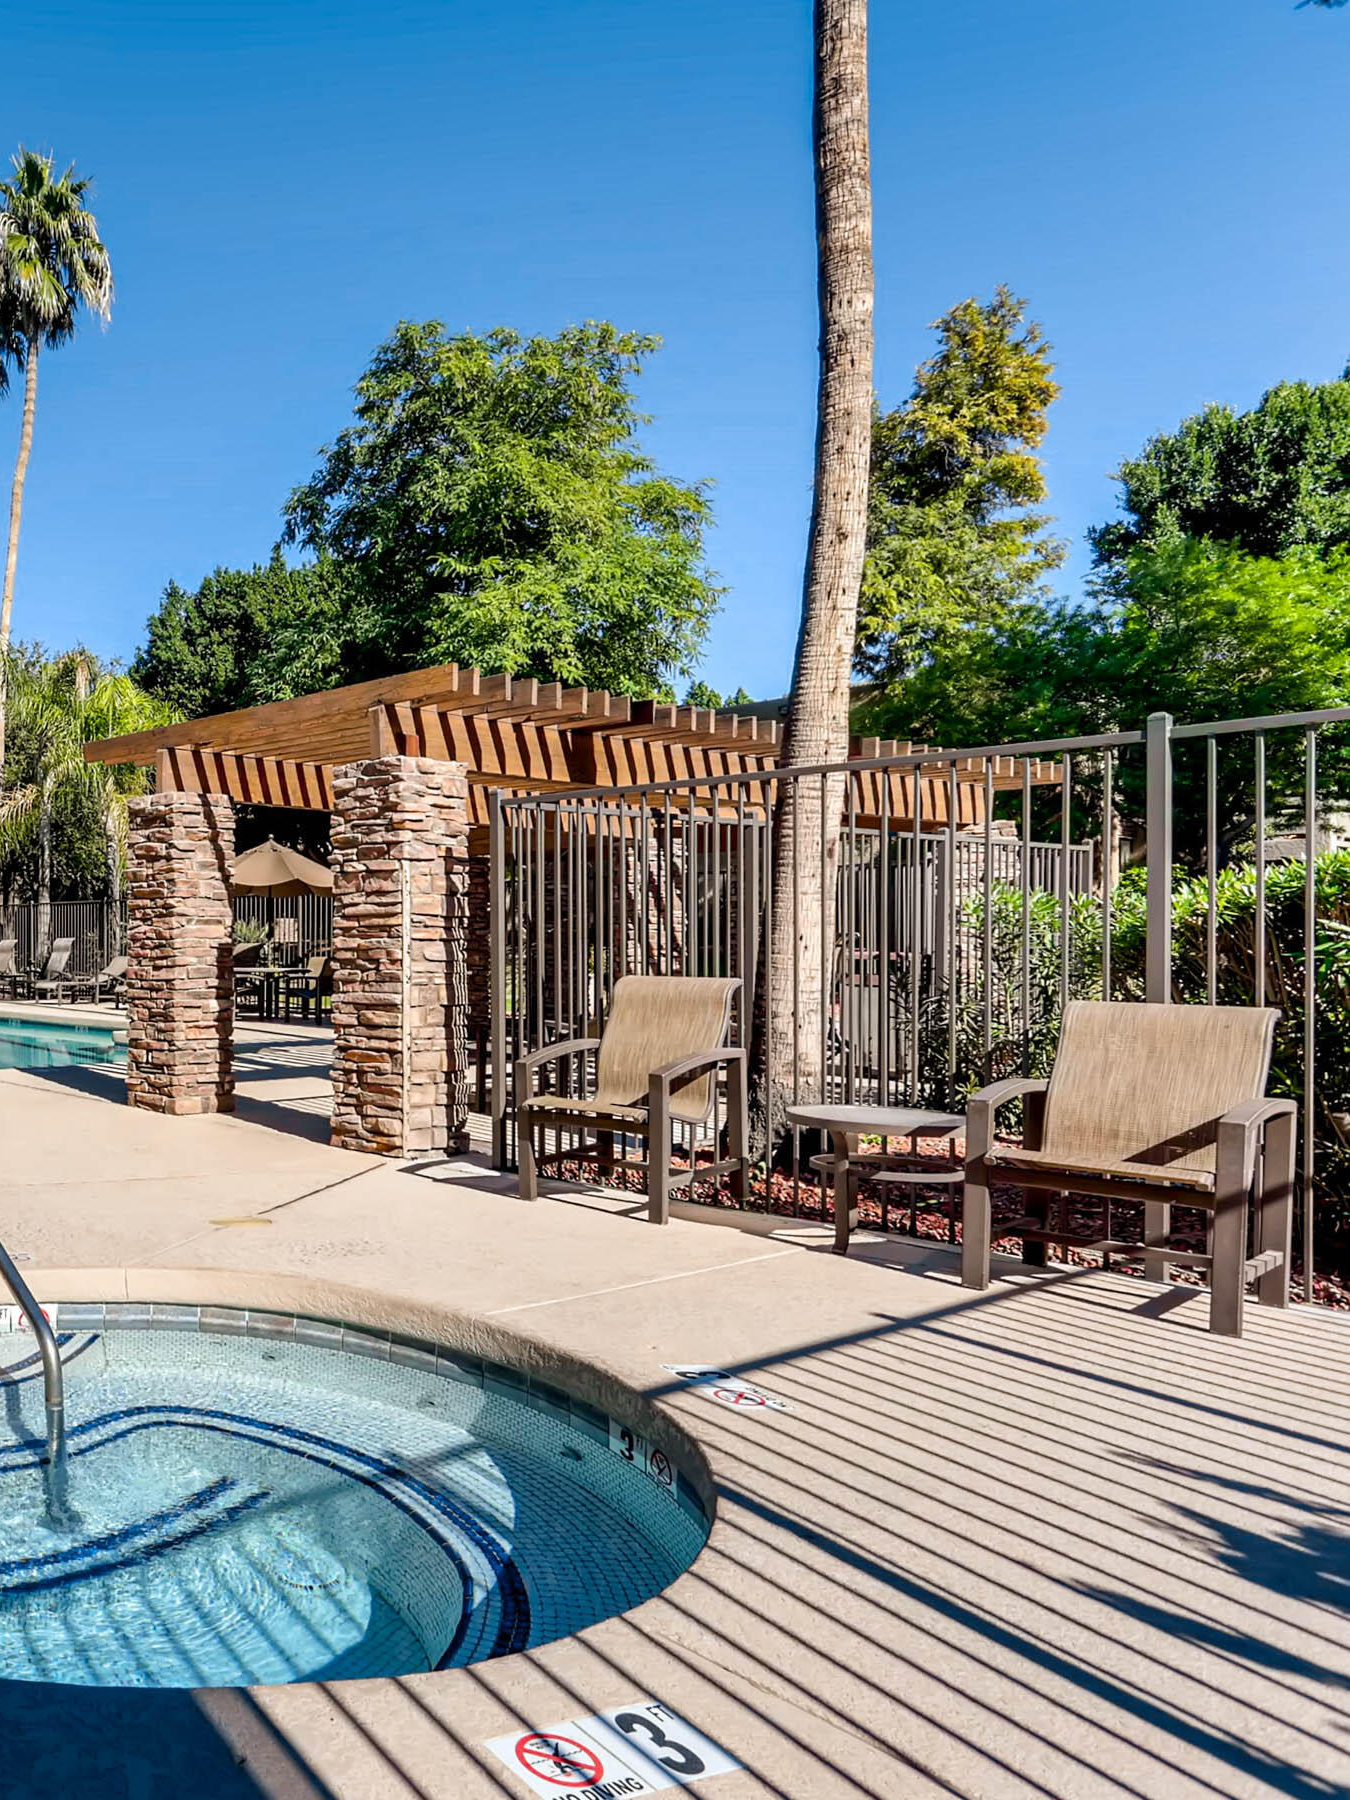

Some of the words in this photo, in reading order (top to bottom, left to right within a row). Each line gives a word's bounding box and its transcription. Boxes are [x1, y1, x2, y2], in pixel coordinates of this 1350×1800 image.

[620, 1429, 634, 1461] 3
[645, 1703, 674, 1723] FT
[614, 1712, 706, 1776] 3
[580, 1777, 644, 1800] DIVING
